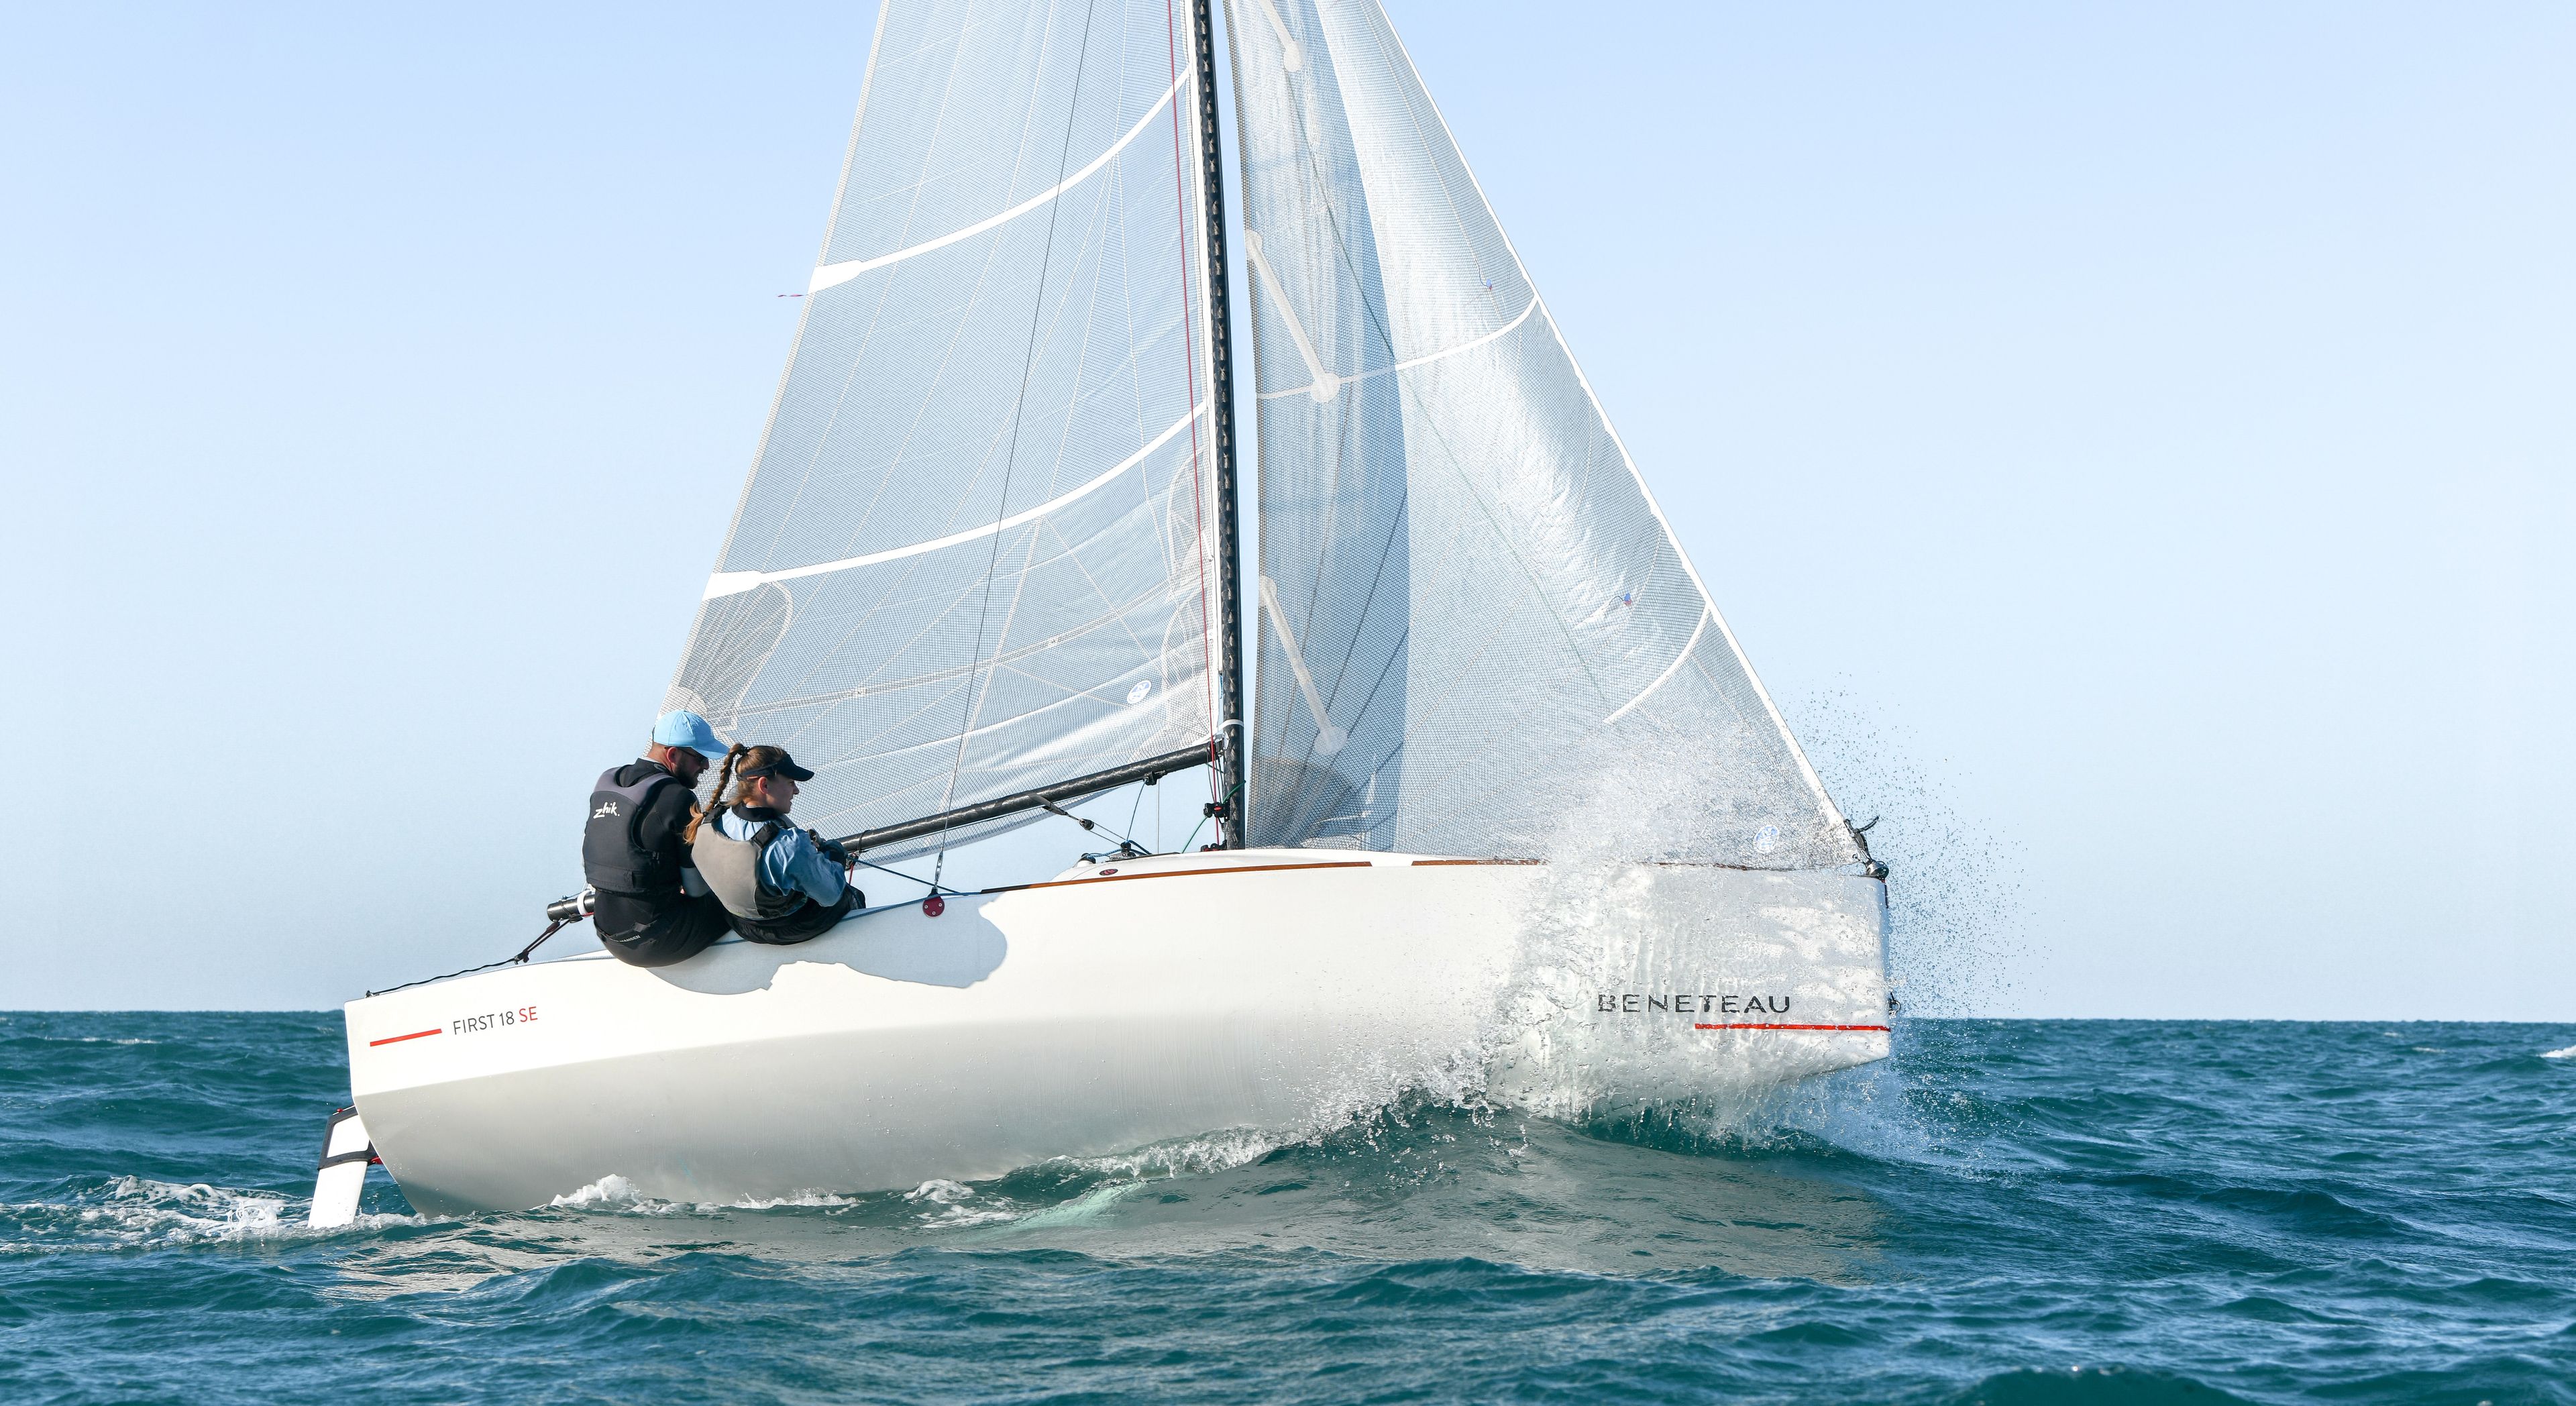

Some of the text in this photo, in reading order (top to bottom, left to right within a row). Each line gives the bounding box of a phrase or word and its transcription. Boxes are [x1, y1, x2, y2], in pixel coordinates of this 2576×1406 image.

[1597, 993, 1790, 1014] BENETEAU
[453, 1006, 538, 1035] FIRST 18 SE
